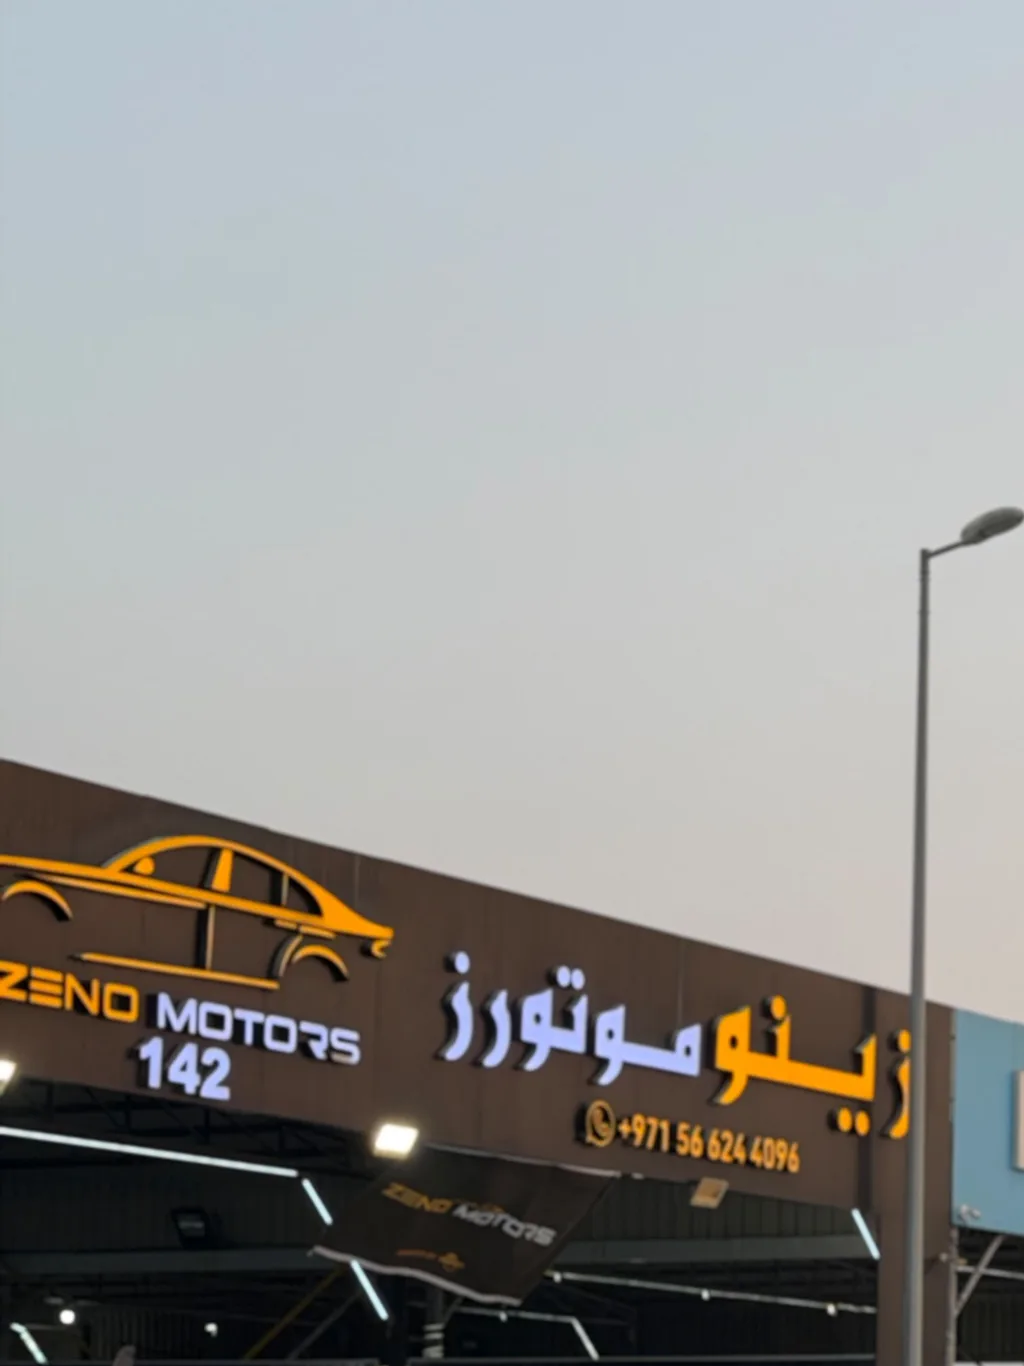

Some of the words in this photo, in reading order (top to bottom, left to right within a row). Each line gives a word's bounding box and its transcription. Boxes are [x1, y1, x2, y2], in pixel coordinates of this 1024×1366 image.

[0, 959, 140, 1023] ZENO
[157, 991, 361, 1065] MOTORS
[443, 951, 701, 1086] موتورز
[138, 1036, 231, 1101] 142
[714, 995, 911, 1138] زينو
[618, 1113, 671, 1152] +971
[675, 1120, 705, 1158] 56
[707, 1127, 747, 1165] 624
[749, 1135, 801, 1174] 4096
[452, 1203, 558, 1247] MOTORS
